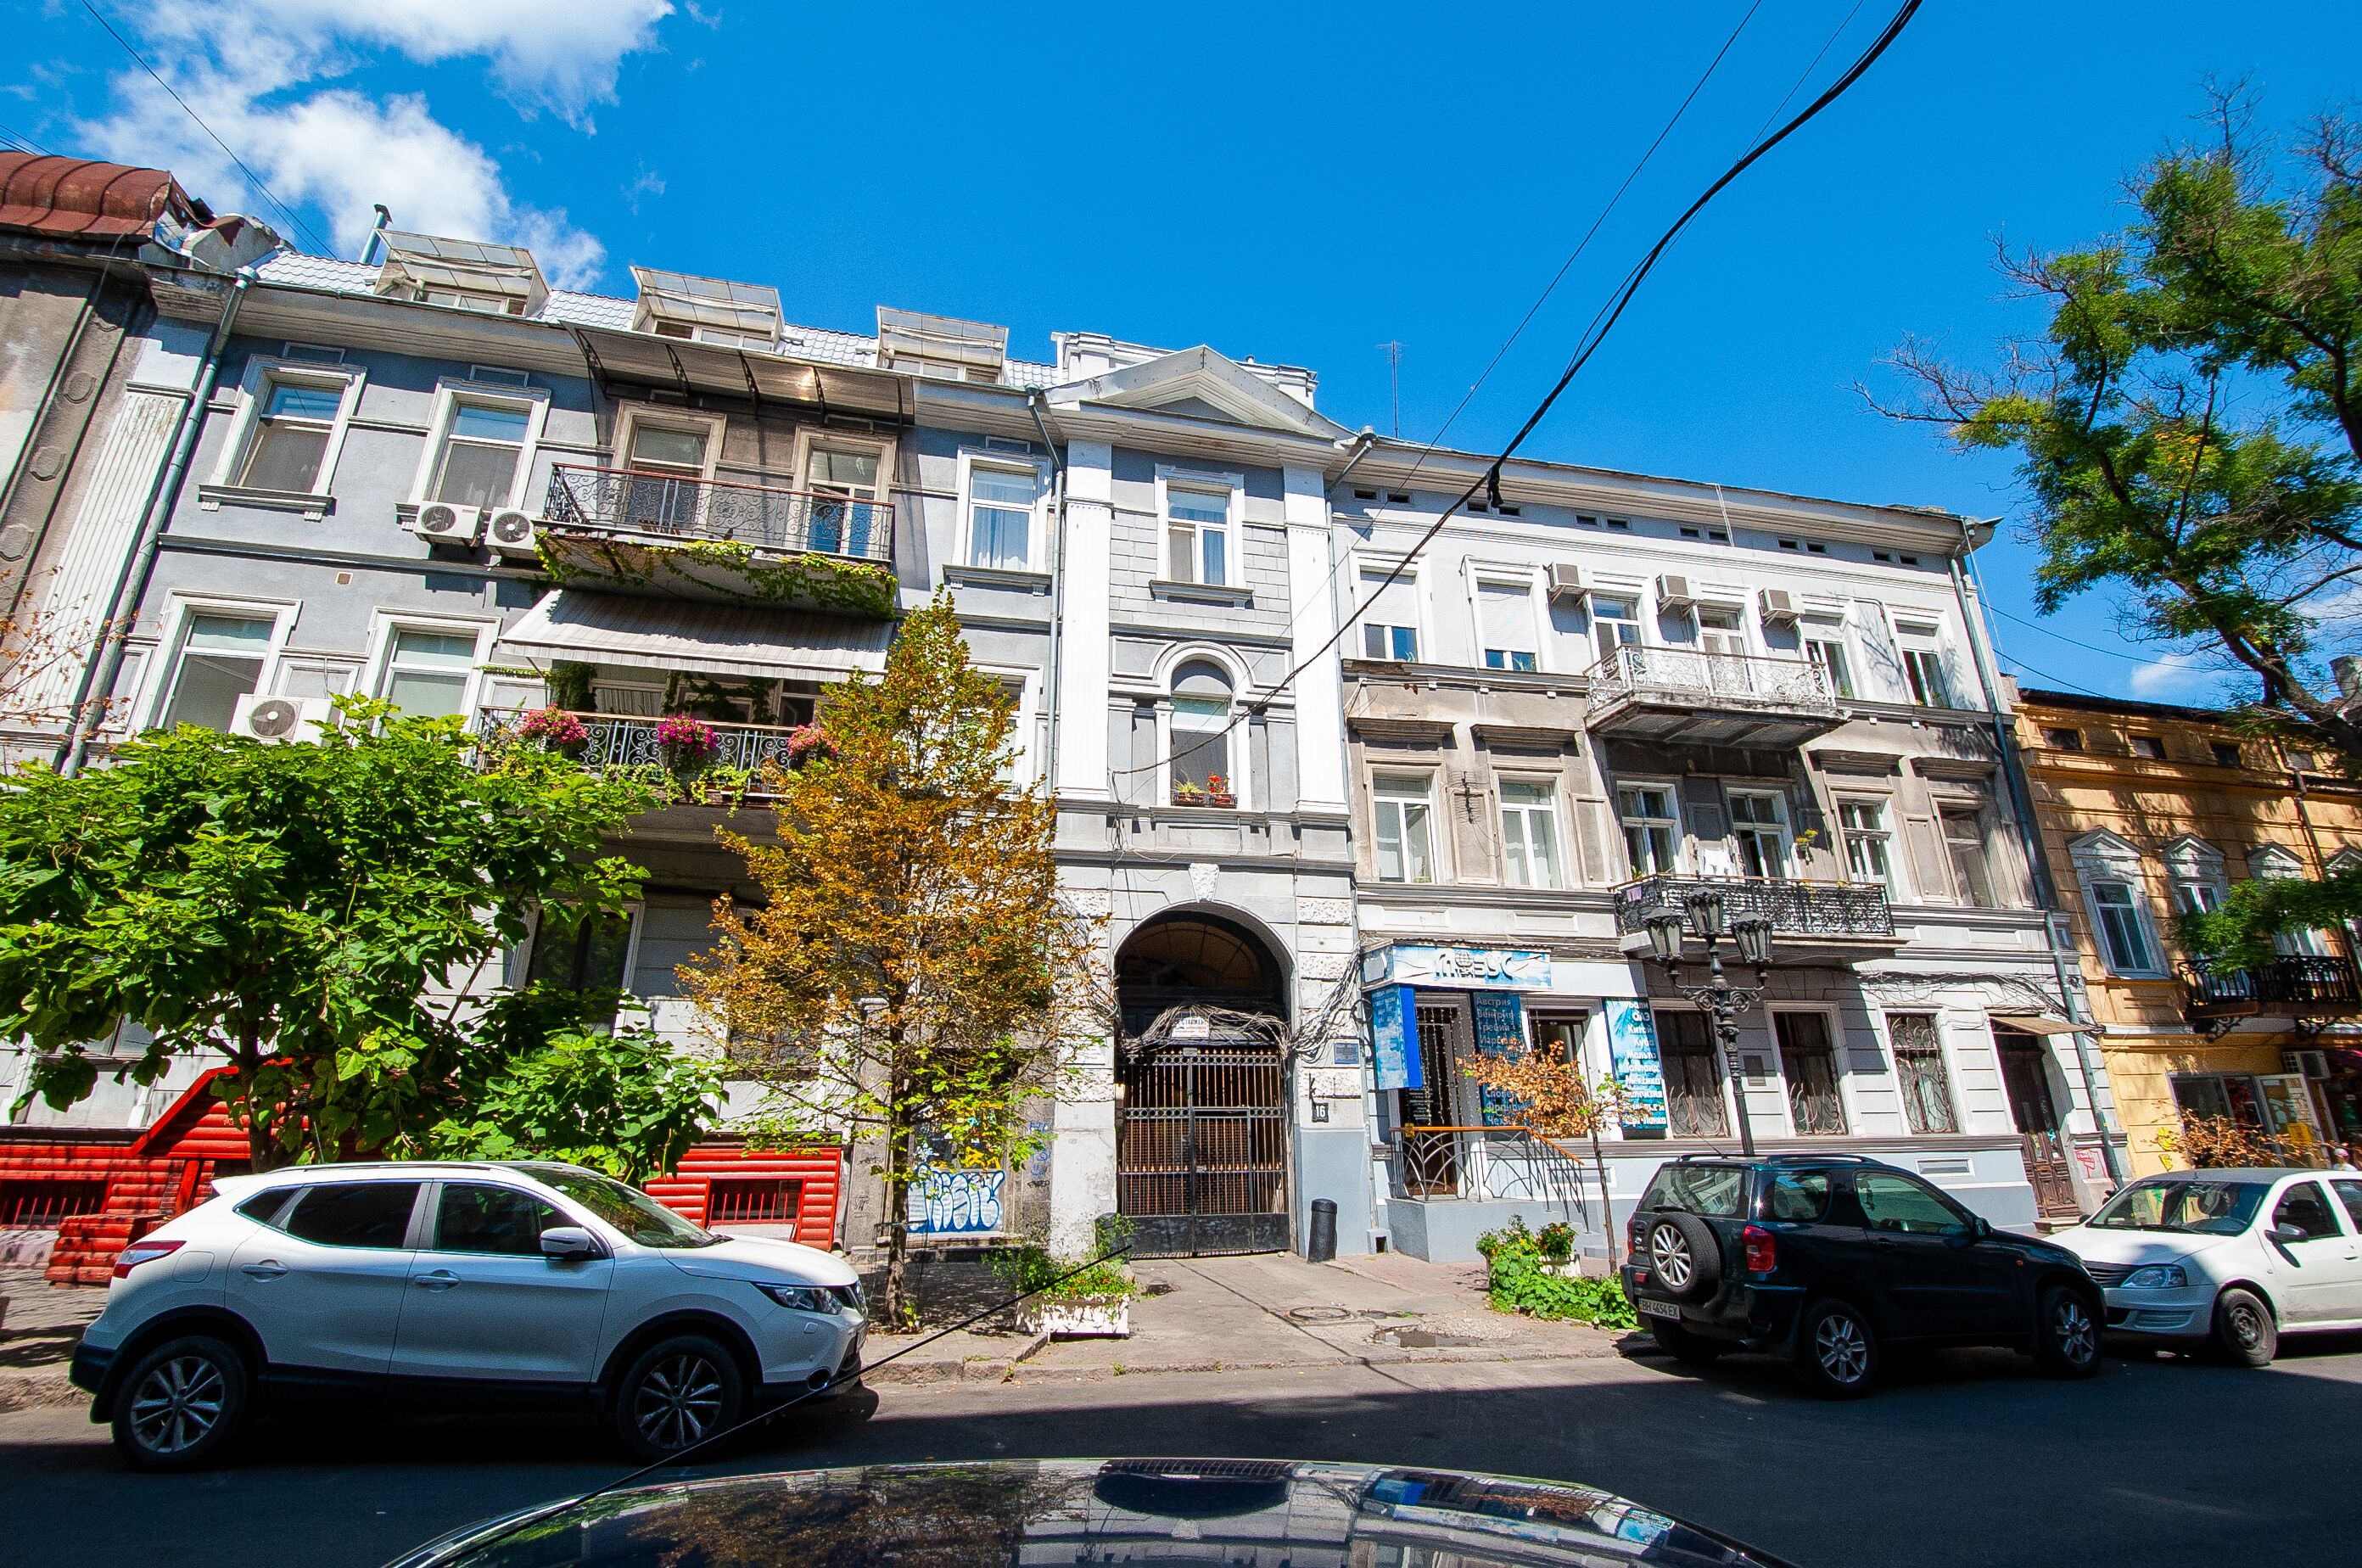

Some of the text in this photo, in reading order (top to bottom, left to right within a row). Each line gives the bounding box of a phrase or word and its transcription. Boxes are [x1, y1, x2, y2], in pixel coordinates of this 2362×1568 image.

[1477, 996, 1511, 1007] Австрия
[1315, 1105, 1326, 1117] 16
[1643, 1300, 1651, 1312] BH
[1668, 1306, 1678, 1318] EX
